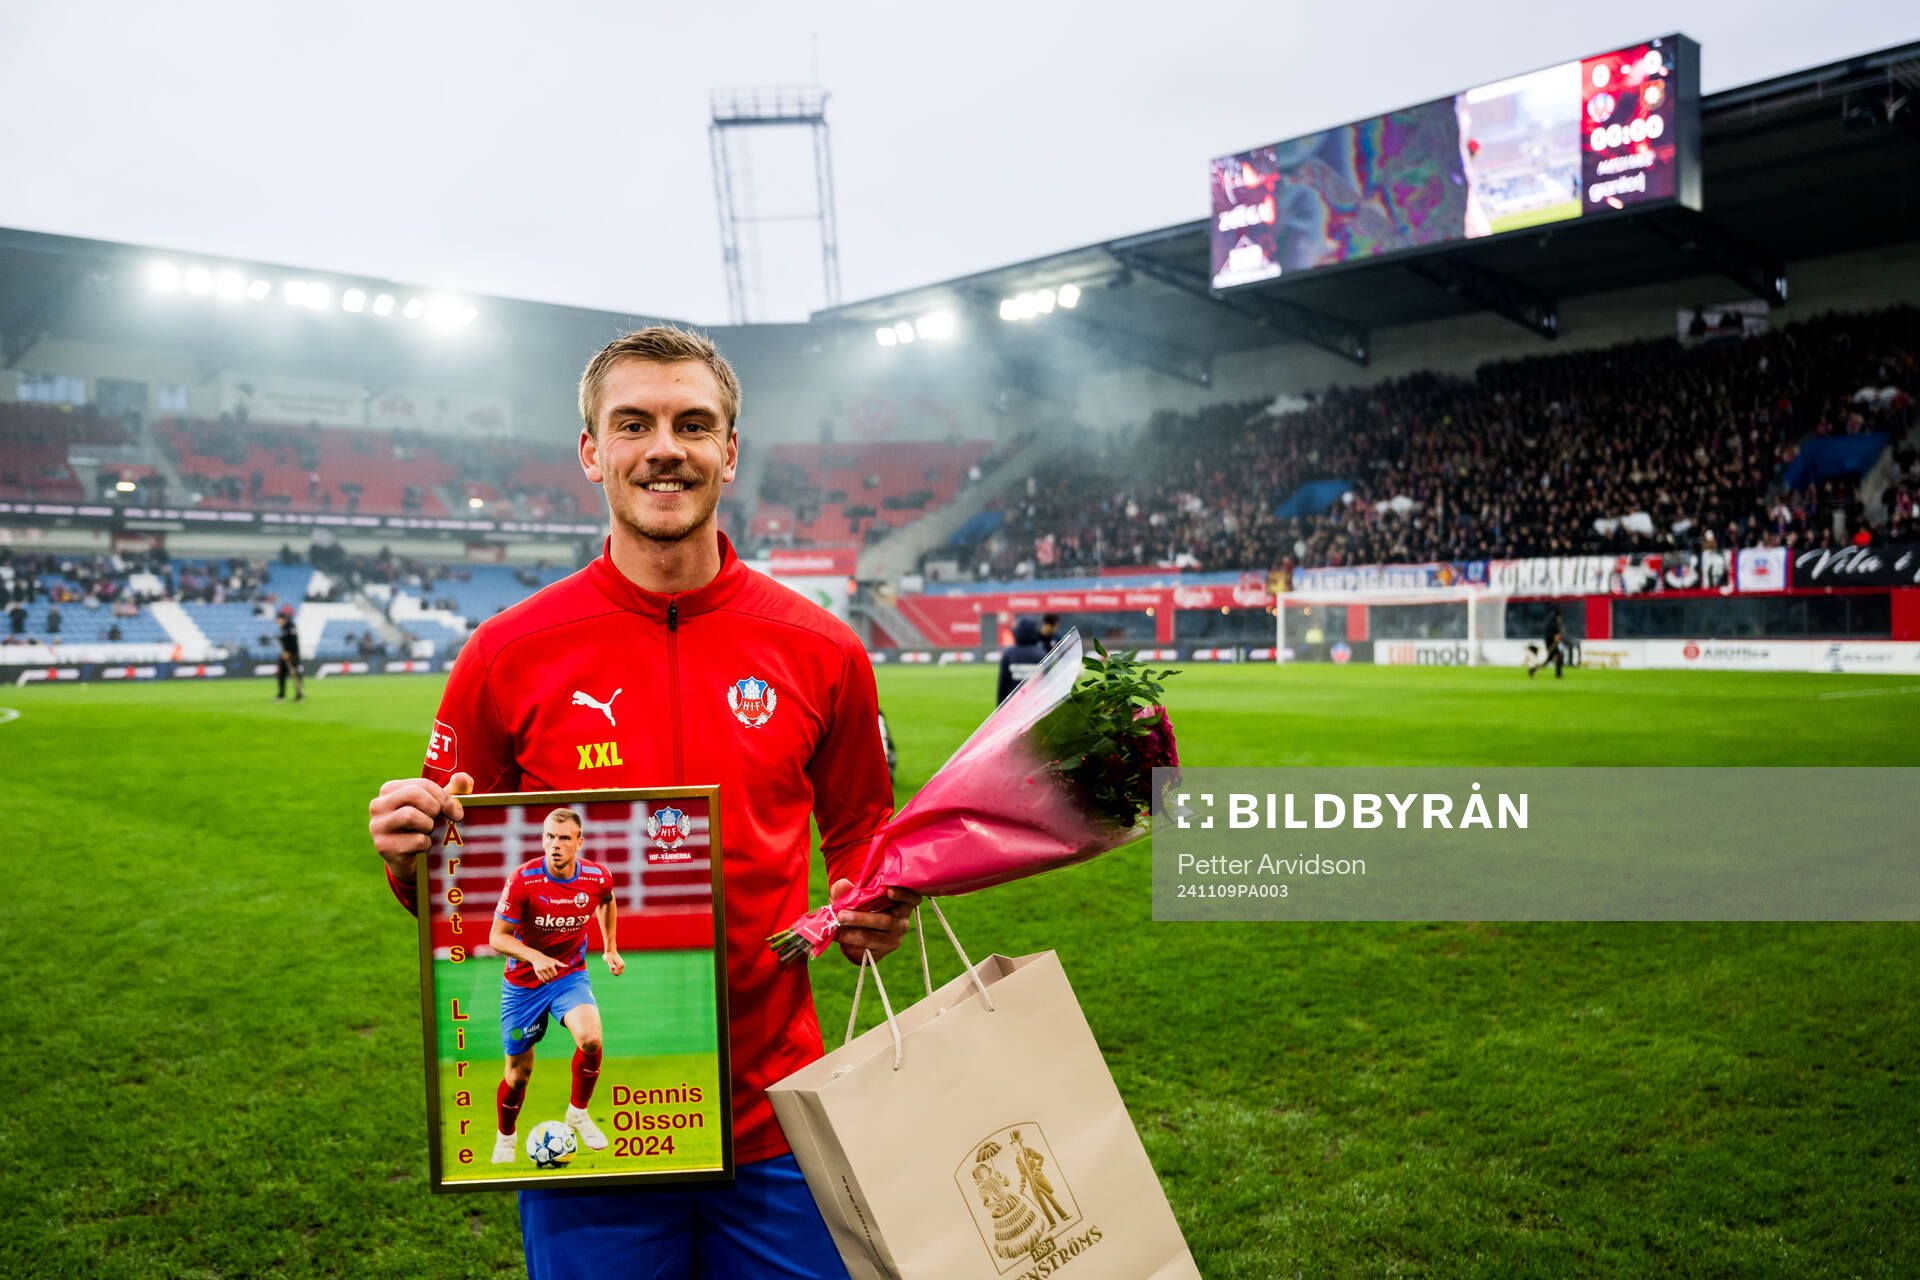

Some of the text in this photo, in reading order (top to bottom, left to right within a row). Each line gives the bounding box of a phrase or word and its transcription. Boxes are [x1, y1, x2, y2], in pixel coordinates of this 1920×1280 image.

[1590, 114, 1664, 151] 00:00
[743, 701, 761, 712] HIF
[429, 730, 452, 753] ET
[576, 741, 624, 770] XXL
[451, 999, 475, 1166] Lirare
[612, 1082, 703, 1107] Dennis
[612, 1110, 704, 1132] Olsson
[613, 1134, 675, 1157] 2024
